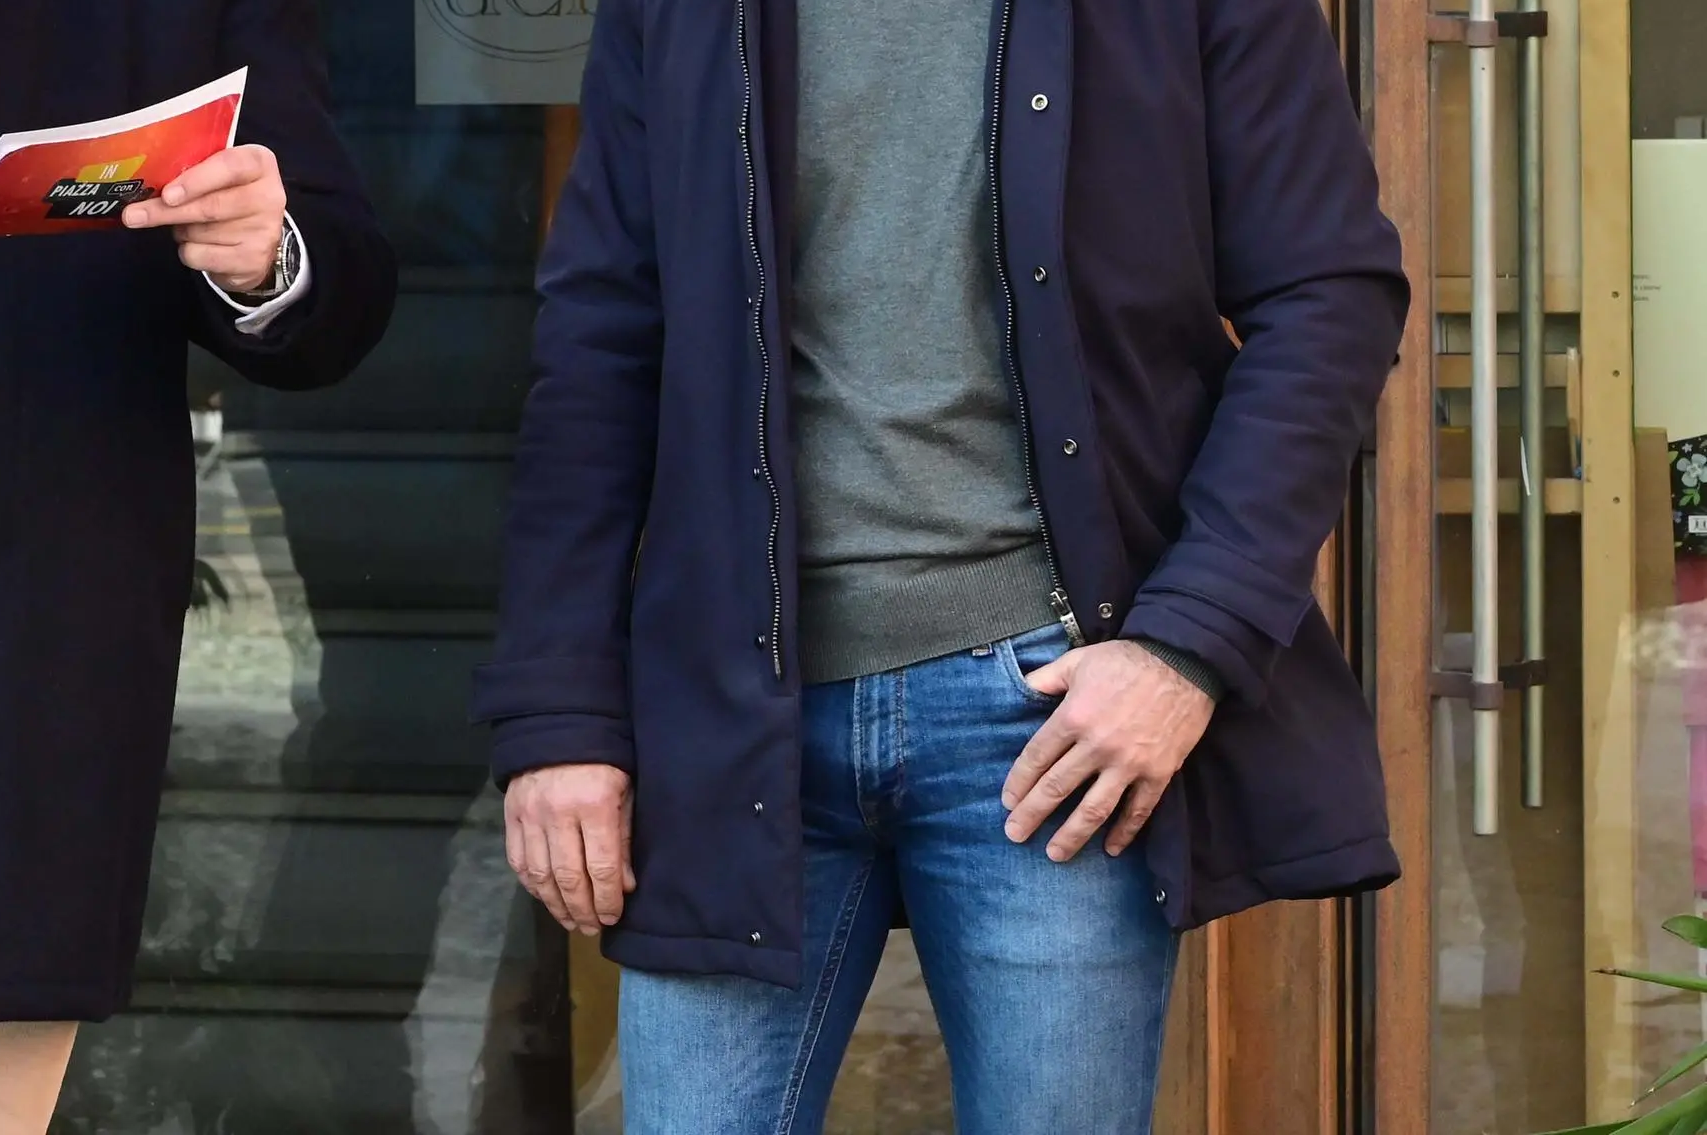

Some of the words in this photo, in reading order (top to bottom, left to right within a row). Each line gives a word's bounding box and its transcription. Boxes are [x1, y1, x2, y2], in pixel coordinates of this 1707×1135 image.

[99, 164, 119, 179] IN
[50, 182, 101, 197] PIAZZA
[114, 184, 133, 192] con
[69, 200, 119, 215] NOI
